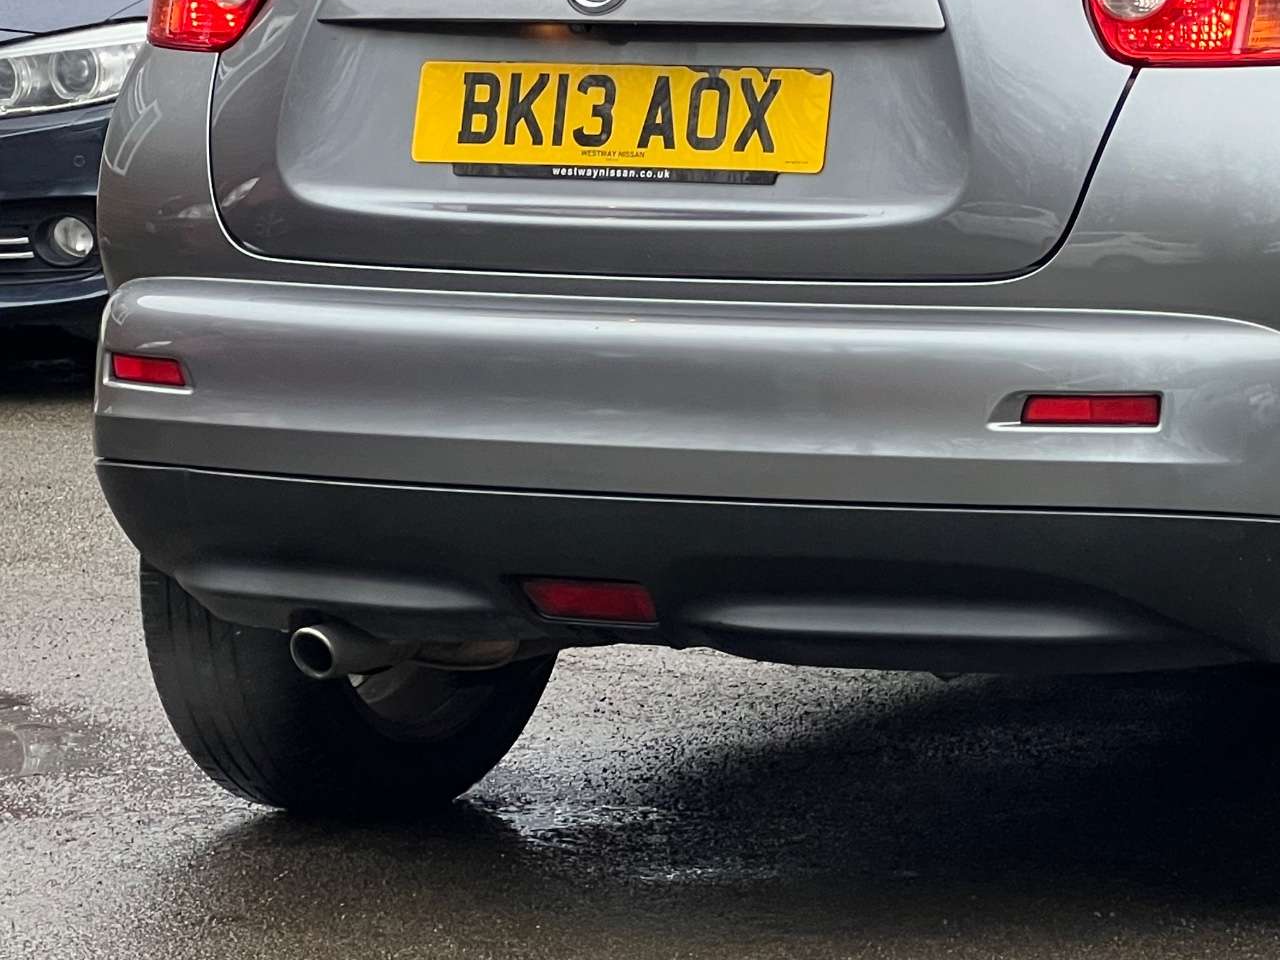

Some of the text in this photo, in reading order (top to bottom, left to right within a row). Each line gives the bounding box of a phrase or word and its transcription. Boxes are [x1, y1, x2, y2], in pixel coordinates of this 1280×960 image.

[456, 71, 783, 154] BK13 AOX
[552, 167, 670, 178] westwaynissan.co.uk
